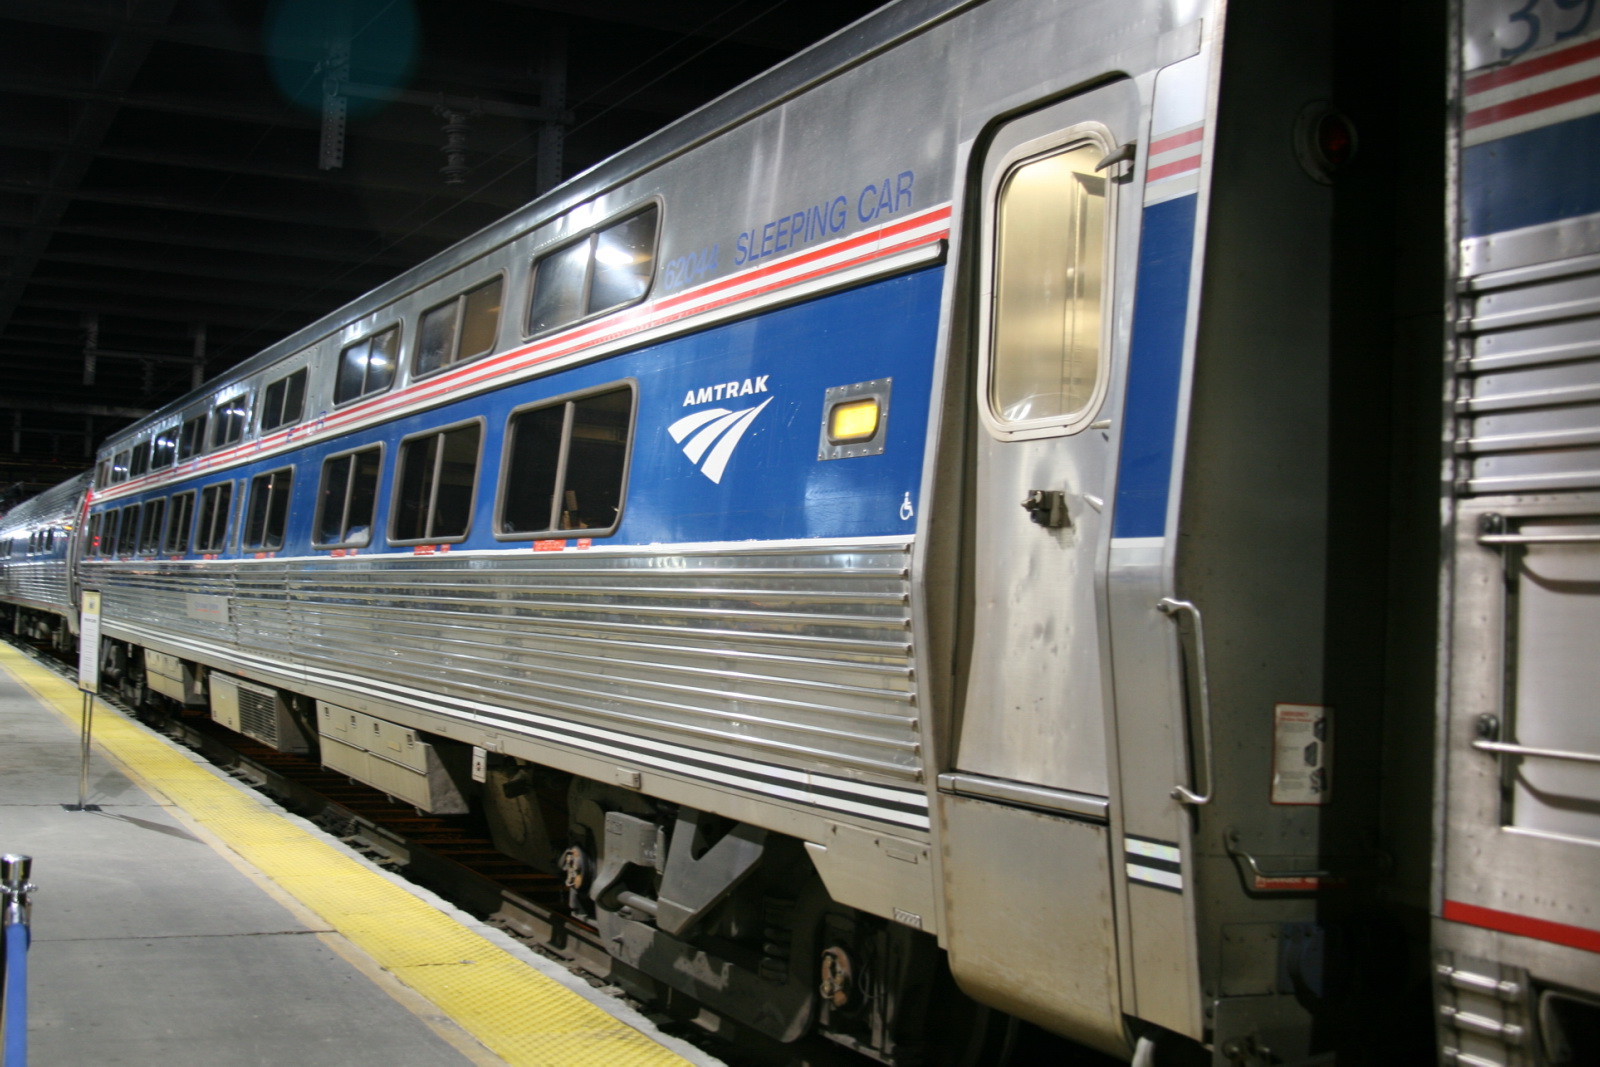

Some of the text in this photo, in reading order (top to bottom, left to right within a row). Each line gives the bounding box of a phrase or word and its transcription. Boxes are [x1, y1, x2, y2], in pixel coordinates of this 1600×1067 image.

[735, 195, 847, 266] SLEEPING
[857, 170, 915, 223] CAR
[682, 374, 769, 407] AMTRAK
